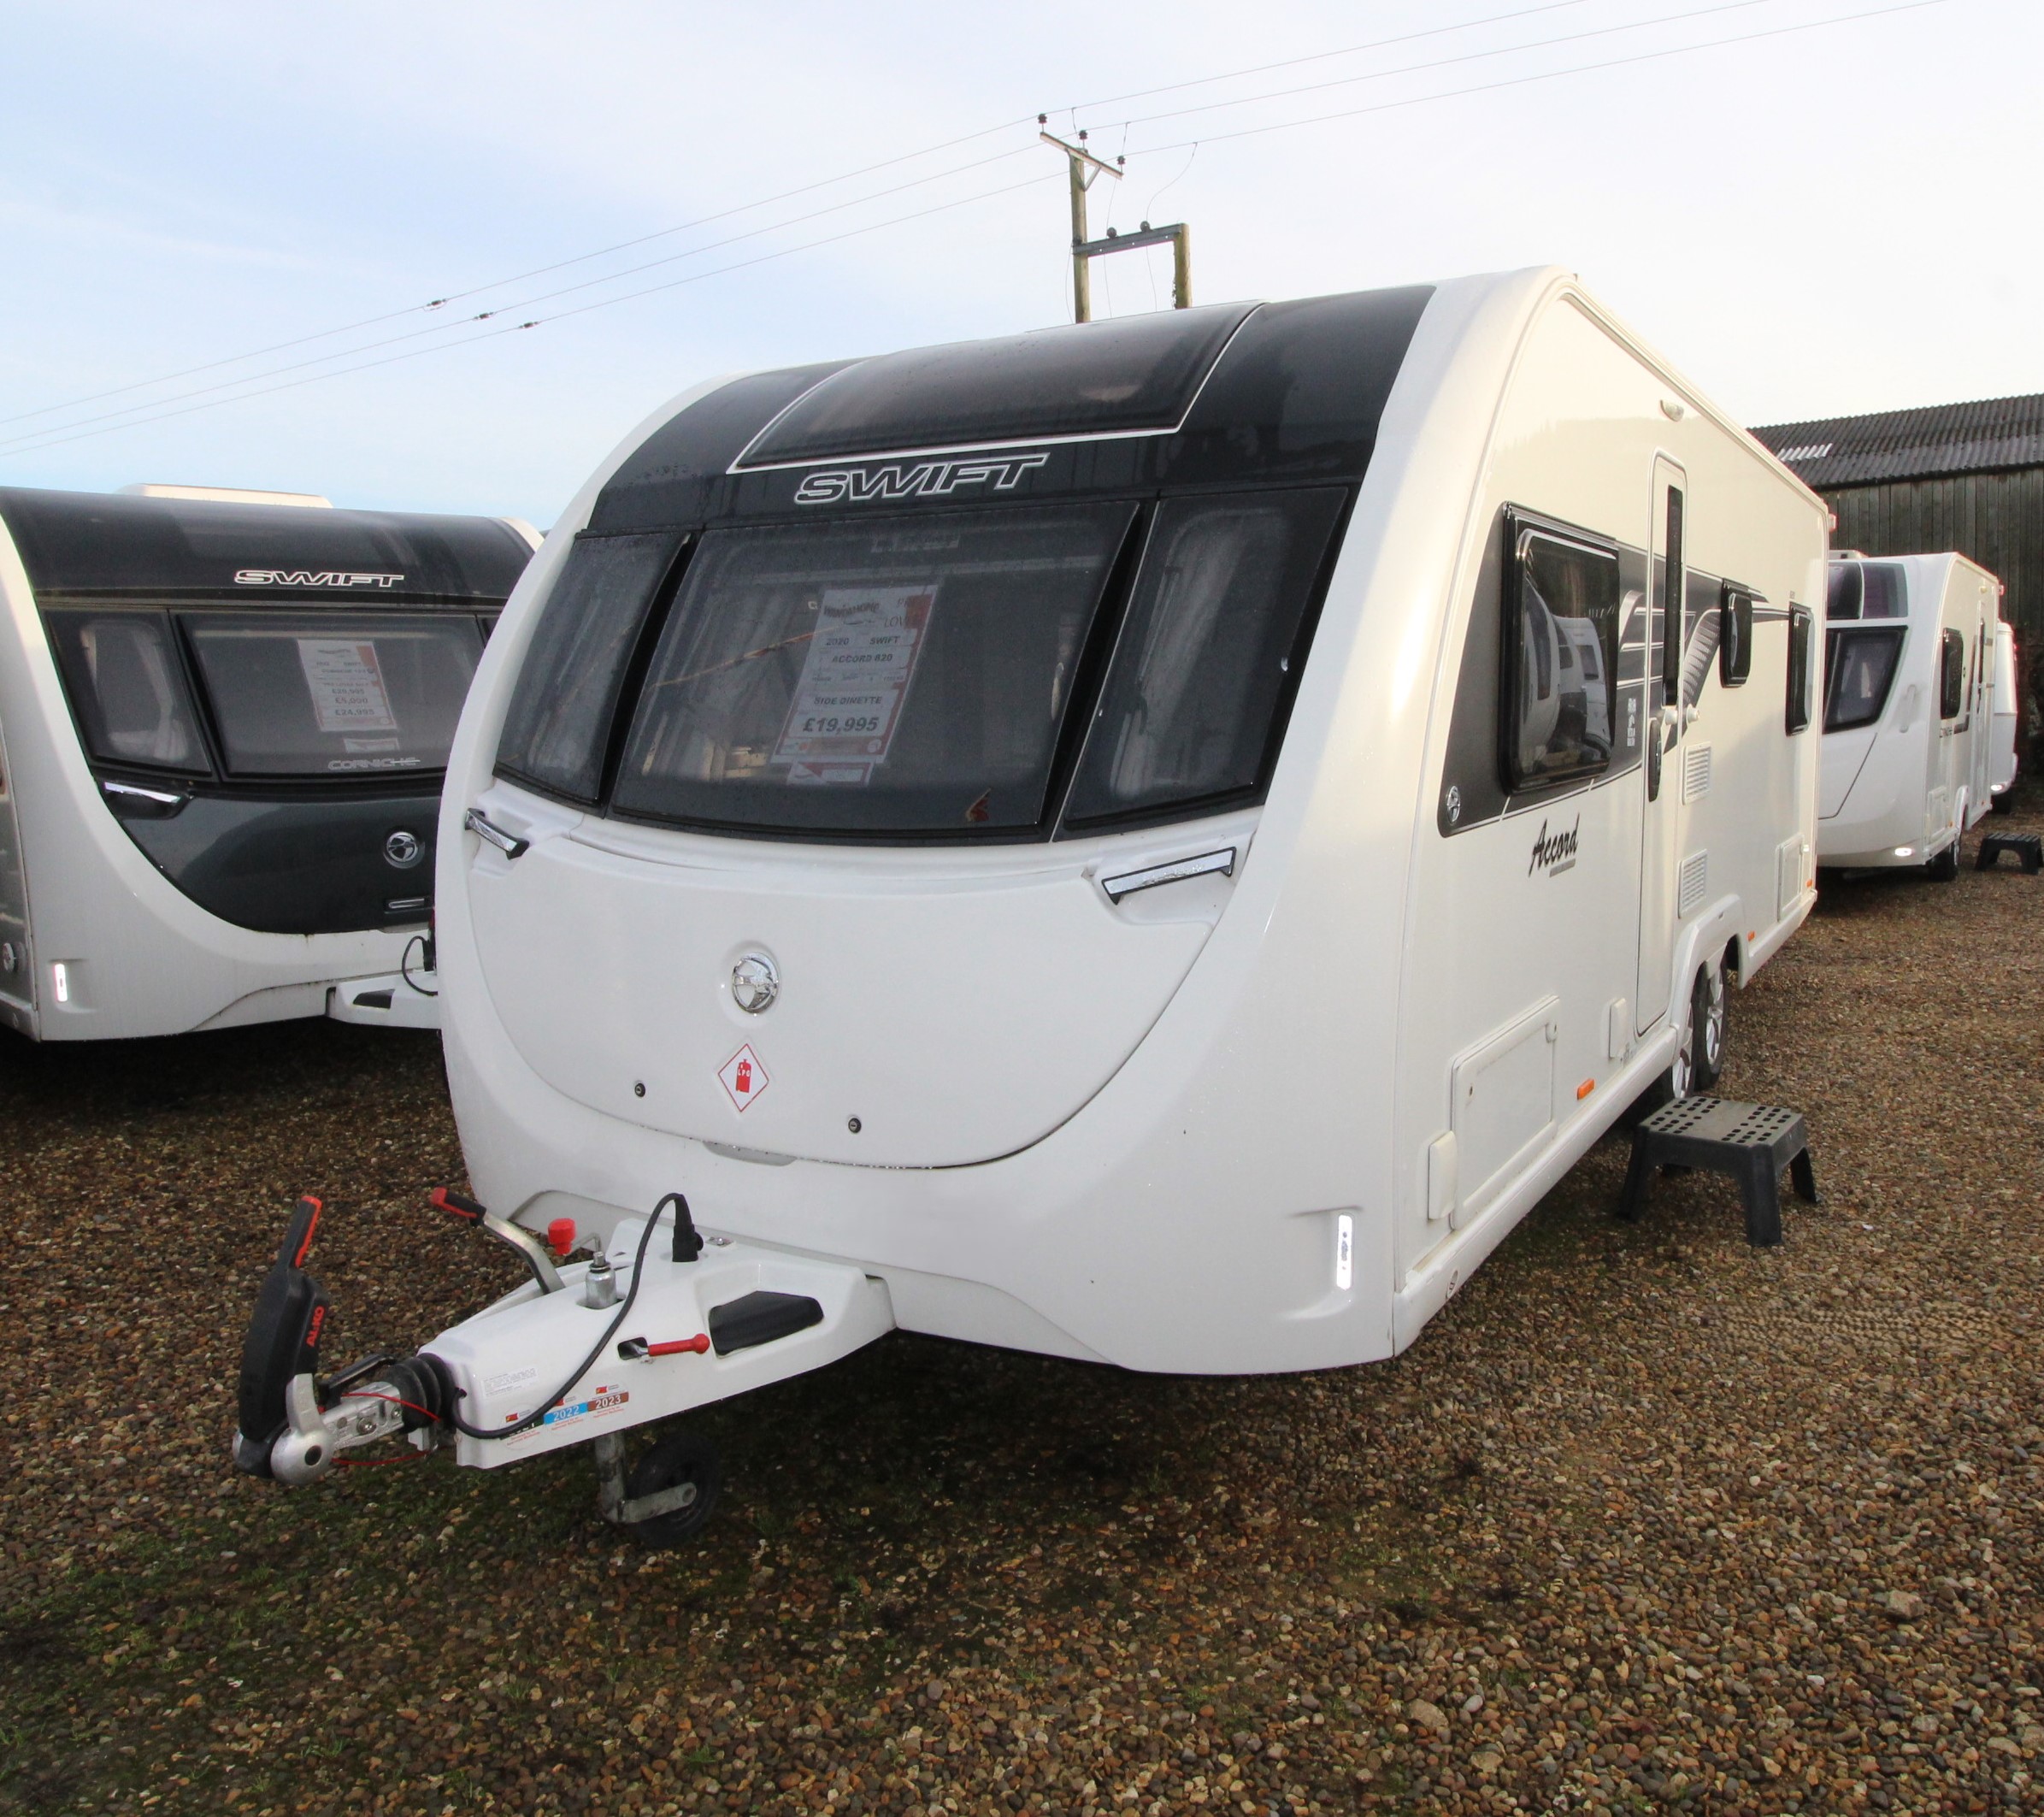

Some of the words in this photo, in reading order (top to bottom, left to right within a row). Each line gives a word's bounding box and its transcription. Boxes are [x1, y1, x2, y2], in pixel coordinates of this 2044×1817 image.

[794, 451, 1051, 505] SWIFT
[234, 569, 404, 587] SWIFT
[869, 635, 901, 645] SWIFT
[832, 654, 872, 664] ACCORD
[813, 696, 837, 705] SIDE
[803, 717, 880, 735] £19,995
[328, 758, 417, 770] CORNICHE
[1529, 811, 1581, 878] Accord
[738, 1068, 751, 1077] LPG
[595, 1395, 621, 1409] 2023
[553, 1405, 580, 1421] 2022
